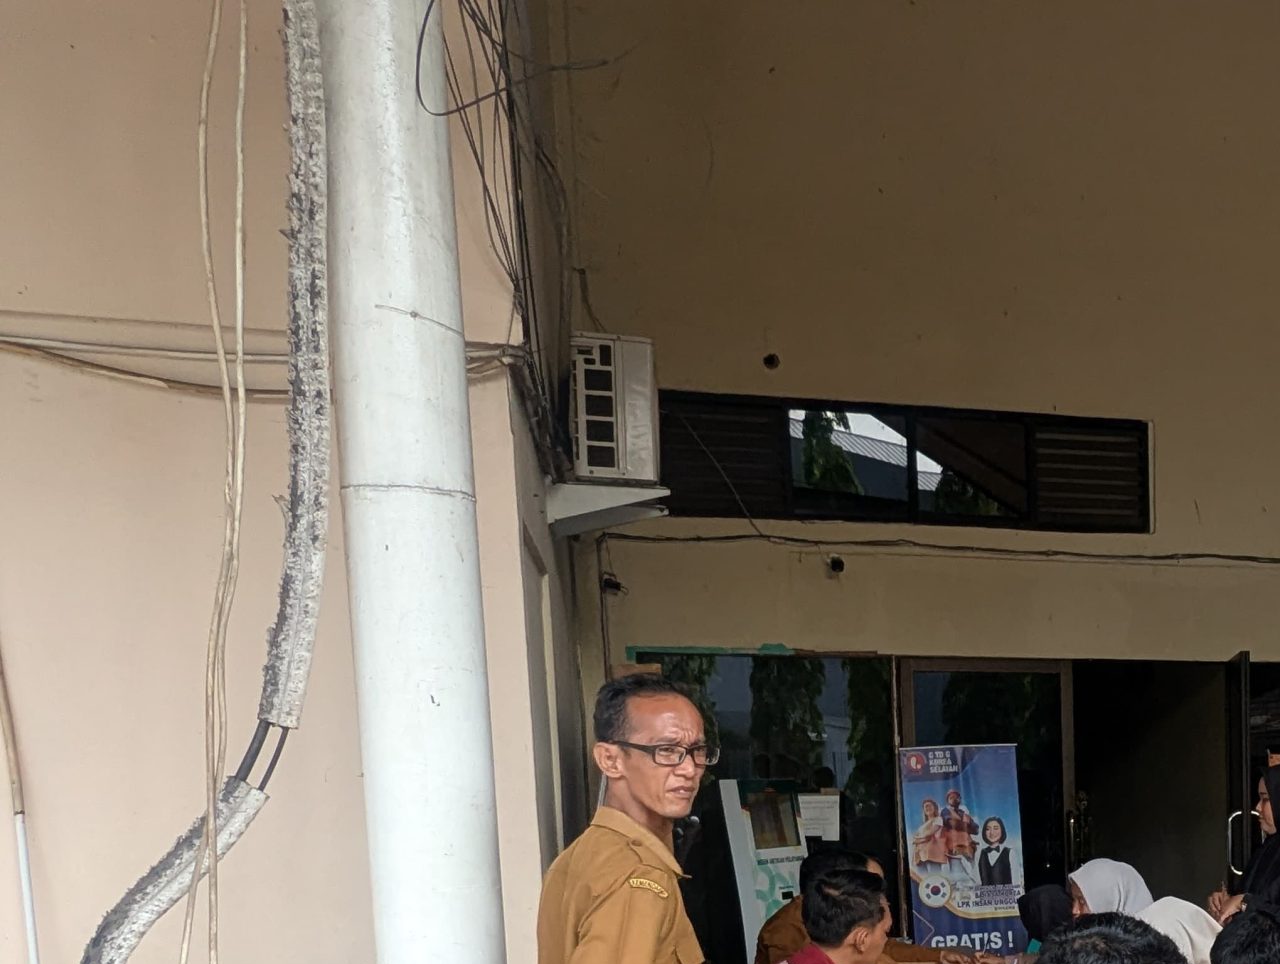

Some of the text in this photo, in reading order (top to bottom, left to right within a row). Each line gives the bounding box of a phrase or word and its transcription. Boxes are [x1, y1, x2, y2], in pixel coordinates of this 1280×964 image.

[929, 758, 952, 766] KOREA
[930, 765, 958, 773] SELATAN
[931, 931, 1003, 950] GRATIS
